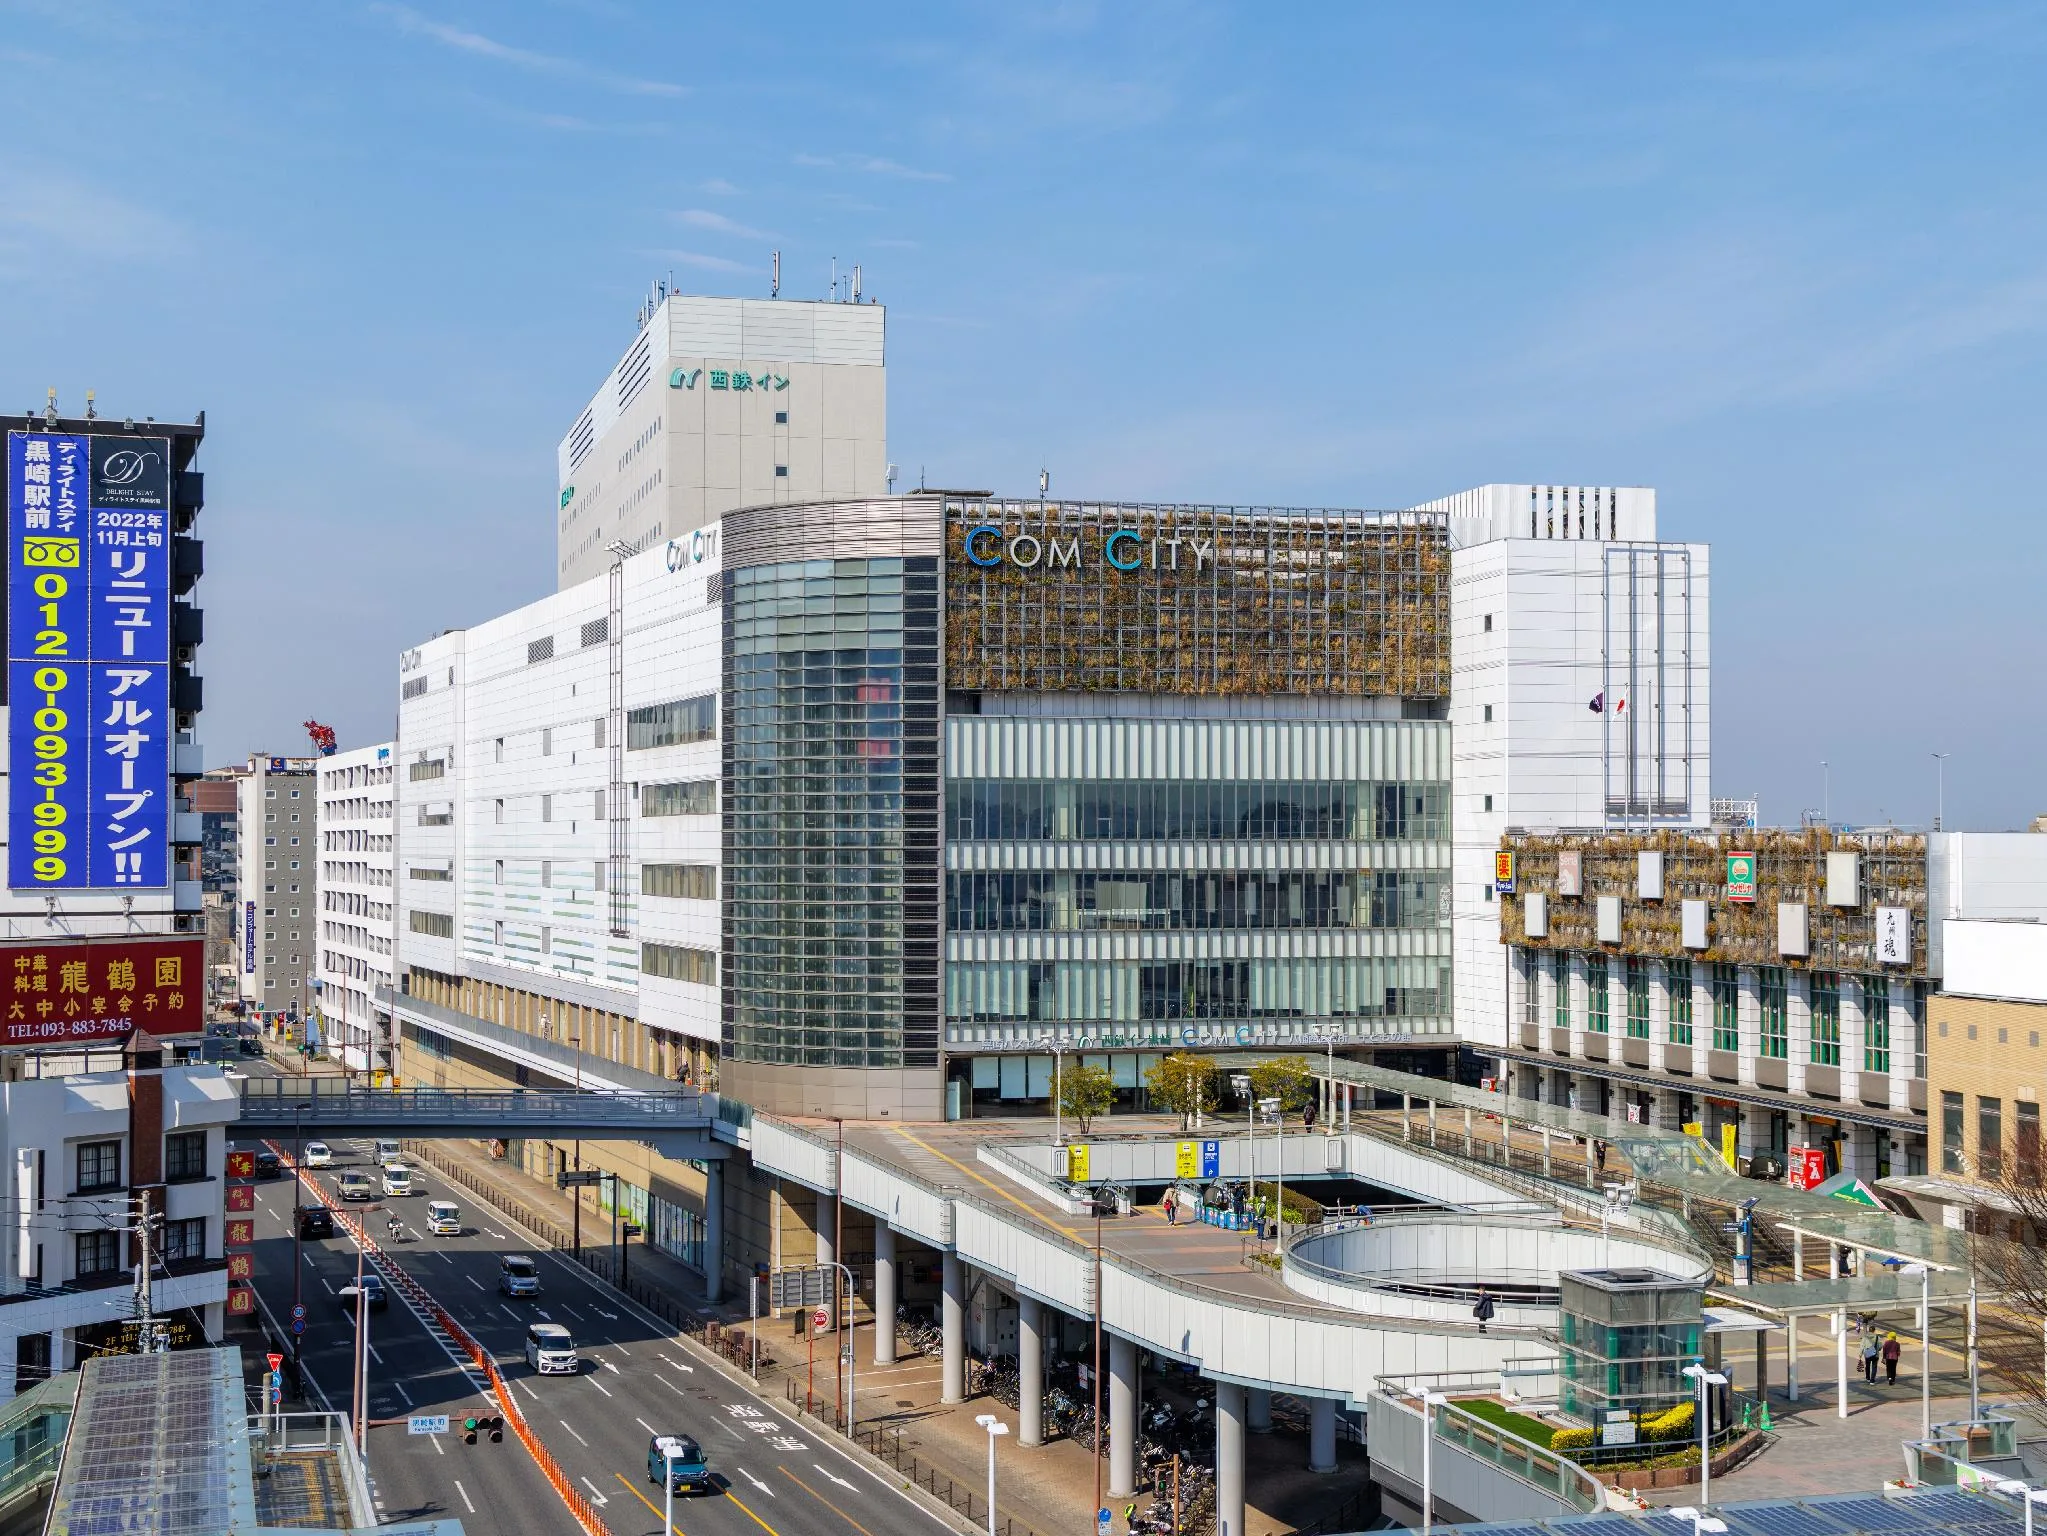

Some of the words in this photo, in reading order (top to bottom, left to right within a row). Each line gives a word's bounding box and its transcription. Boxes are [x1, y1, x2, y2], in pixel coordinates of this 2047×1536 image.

[710, 371, 789, 392] 西鉄イン
[25, 440, 50, 529] 黒崎駅前
[57, 442, 77, 533] ディライトステイ
[97, 512, 163, 528] 2022年
[97, 531, 162, 547] 11月上旬
[965, 526, 1081, 567] COM
[1106, 530, 1209, 571] CITY
[34, 573, 68, 882] 0120-093-999
[1498, 853, 1510, 877] 薬
[1729, 882, 1753, 895] サイゼリヤ
[14, 954, 49, 973] 中華
[14, 974, 49, 993] 料理
[59, 956, 182, 994] 龍鶴園
[8, 991, 184, 1020] 大中小宴会予約
[8, 1017, 132, 1038] TEL:093-883-7845
[1181, 1026, 1228, 1047] COM
[1235, 1025, 1279, 1046] CITY
[231, 1154, 252, 1175] 中華
[231, 1189, 250, 1208] 料理
